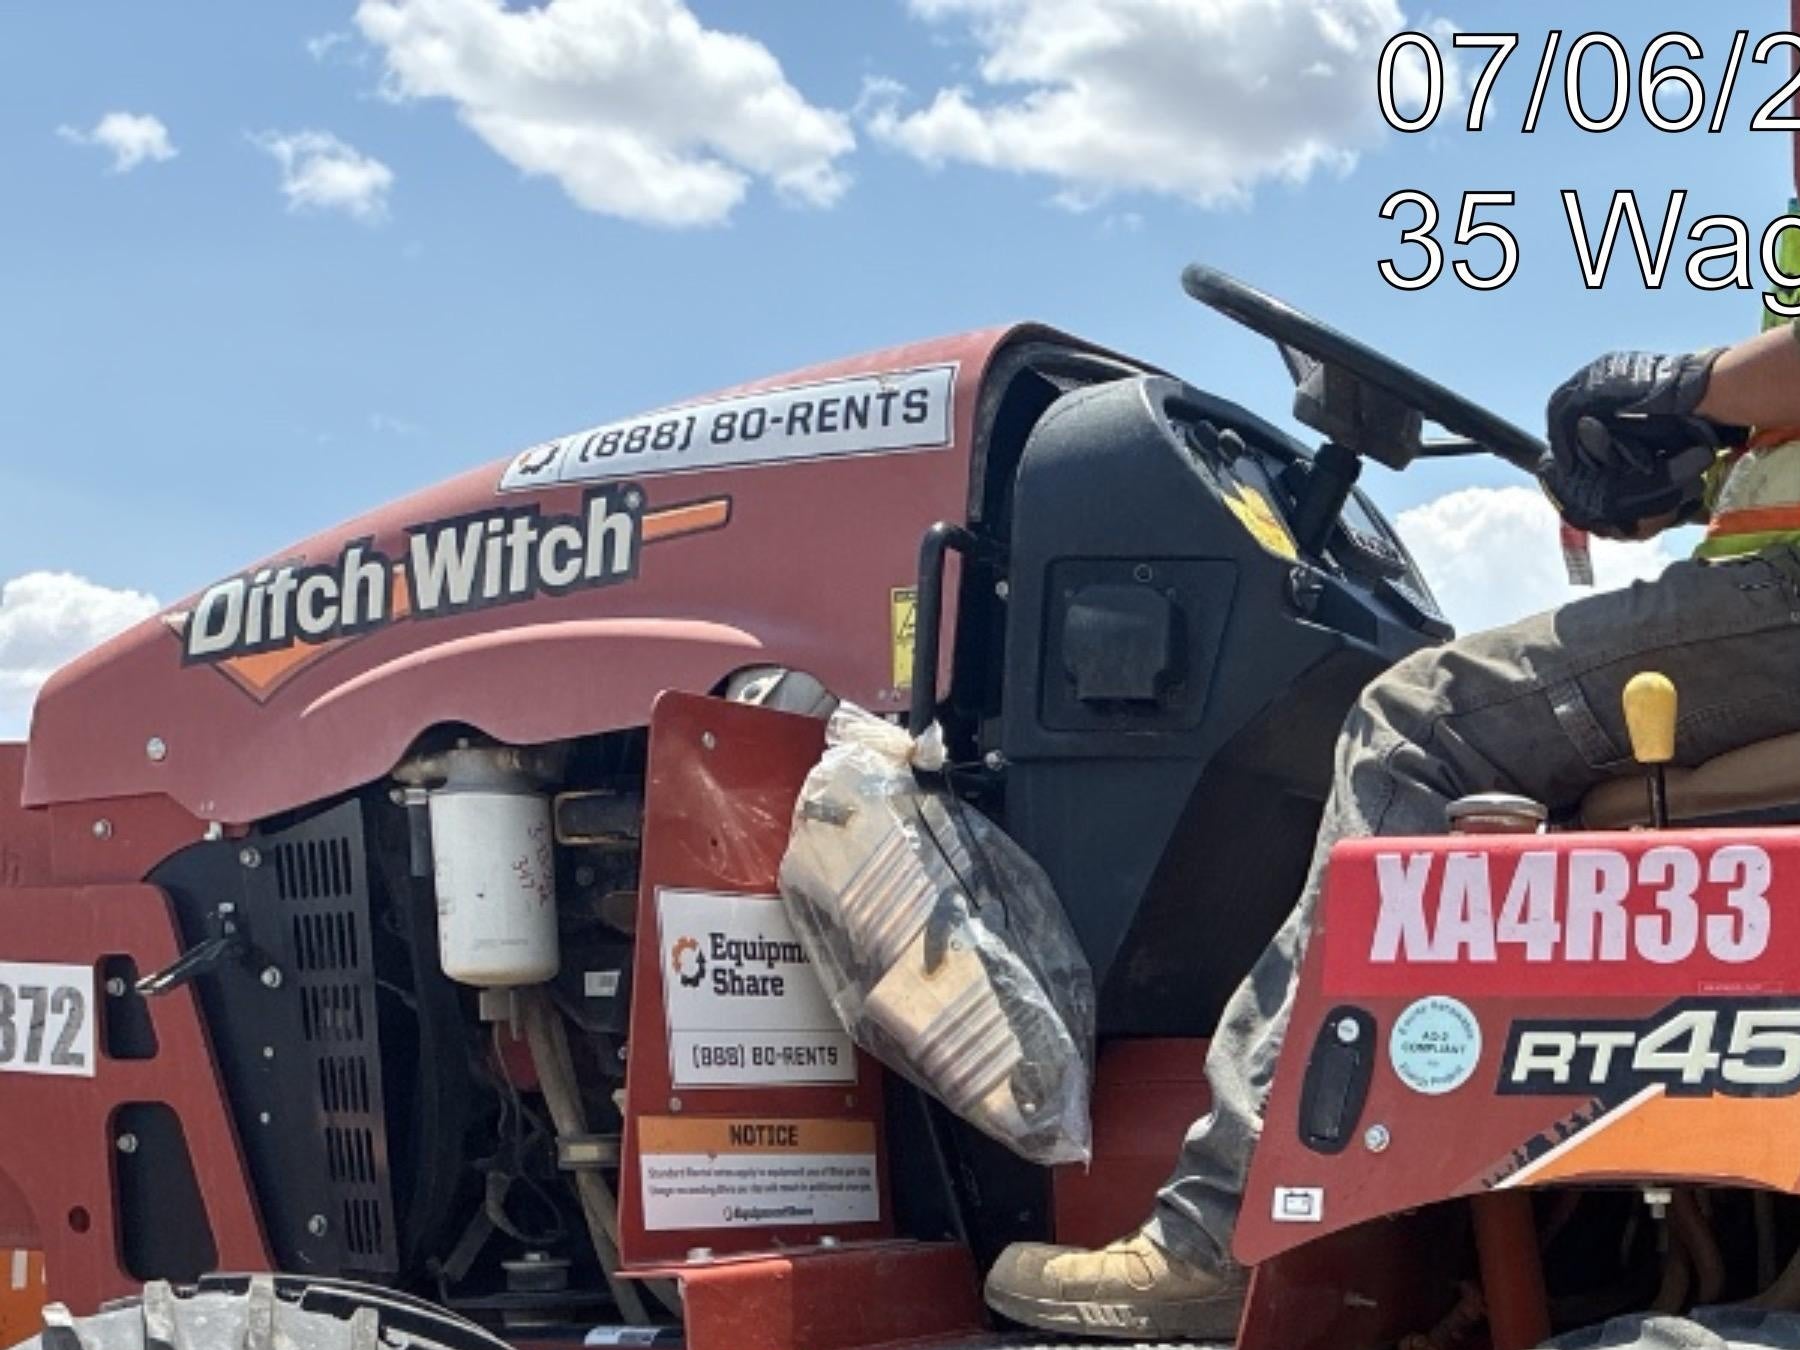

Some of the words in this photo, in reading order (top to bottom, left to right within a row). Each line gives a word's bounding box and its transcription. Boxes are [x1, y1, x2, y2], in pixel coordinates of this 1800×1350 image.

[578, 415, 697, 464] (888)
[709, 387, 929, 445] 80-RENTS
[187, 544, 386, 657] Ditch
[410, 496, 632, 611] Witch
[1370, 845, 1772, 964] XA4R33
[708, 932, 811, 969] Equipm
[713, 968, 785, 997] Share
[752, 1045, 839, 1066] 80-RENTS
[730, 1124, 799, 1147] NOTICE
